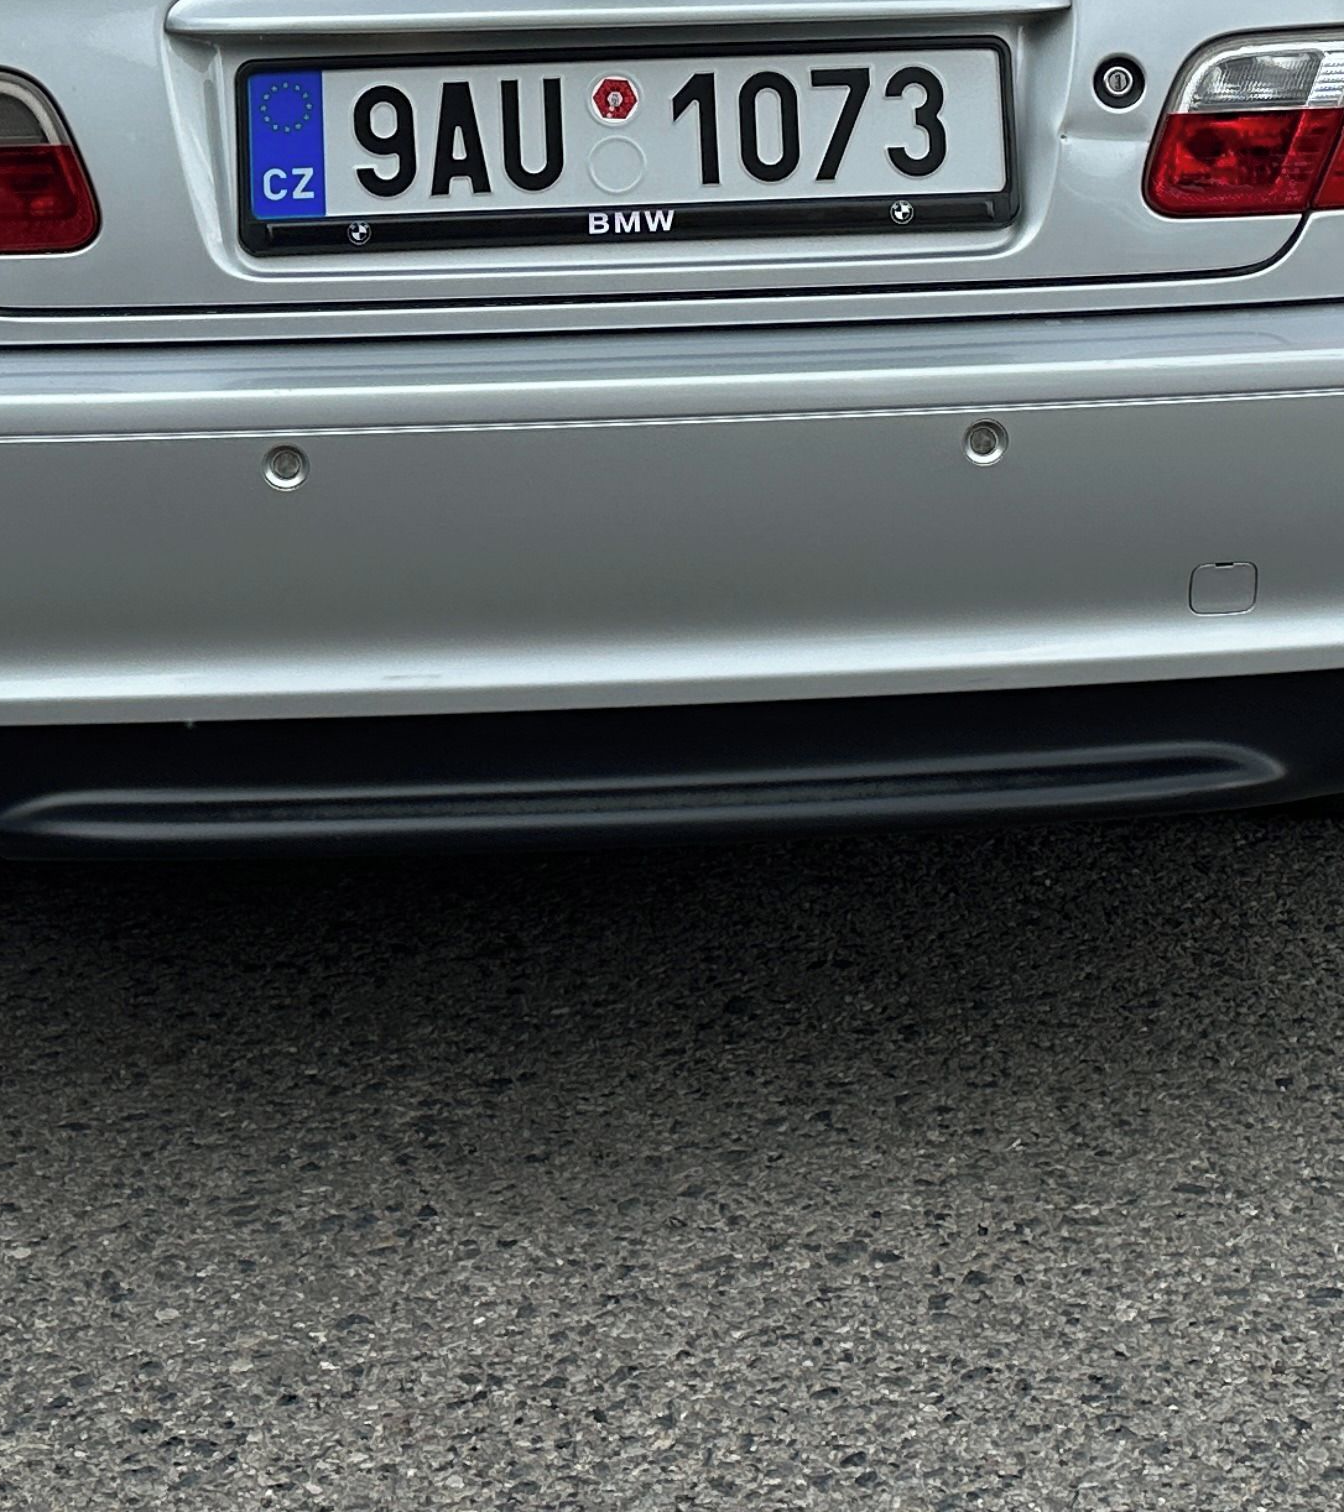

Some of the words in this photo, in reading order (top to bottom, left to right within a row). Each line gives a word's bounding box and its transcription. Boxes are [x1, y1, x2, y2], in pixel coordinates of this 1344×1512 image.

[262, 167, 315, 201] CZ
[353, 76, 565, 199] 9AU
[672, 66, 948, 186] 1073
[587, 208, 675, 235] BMW
